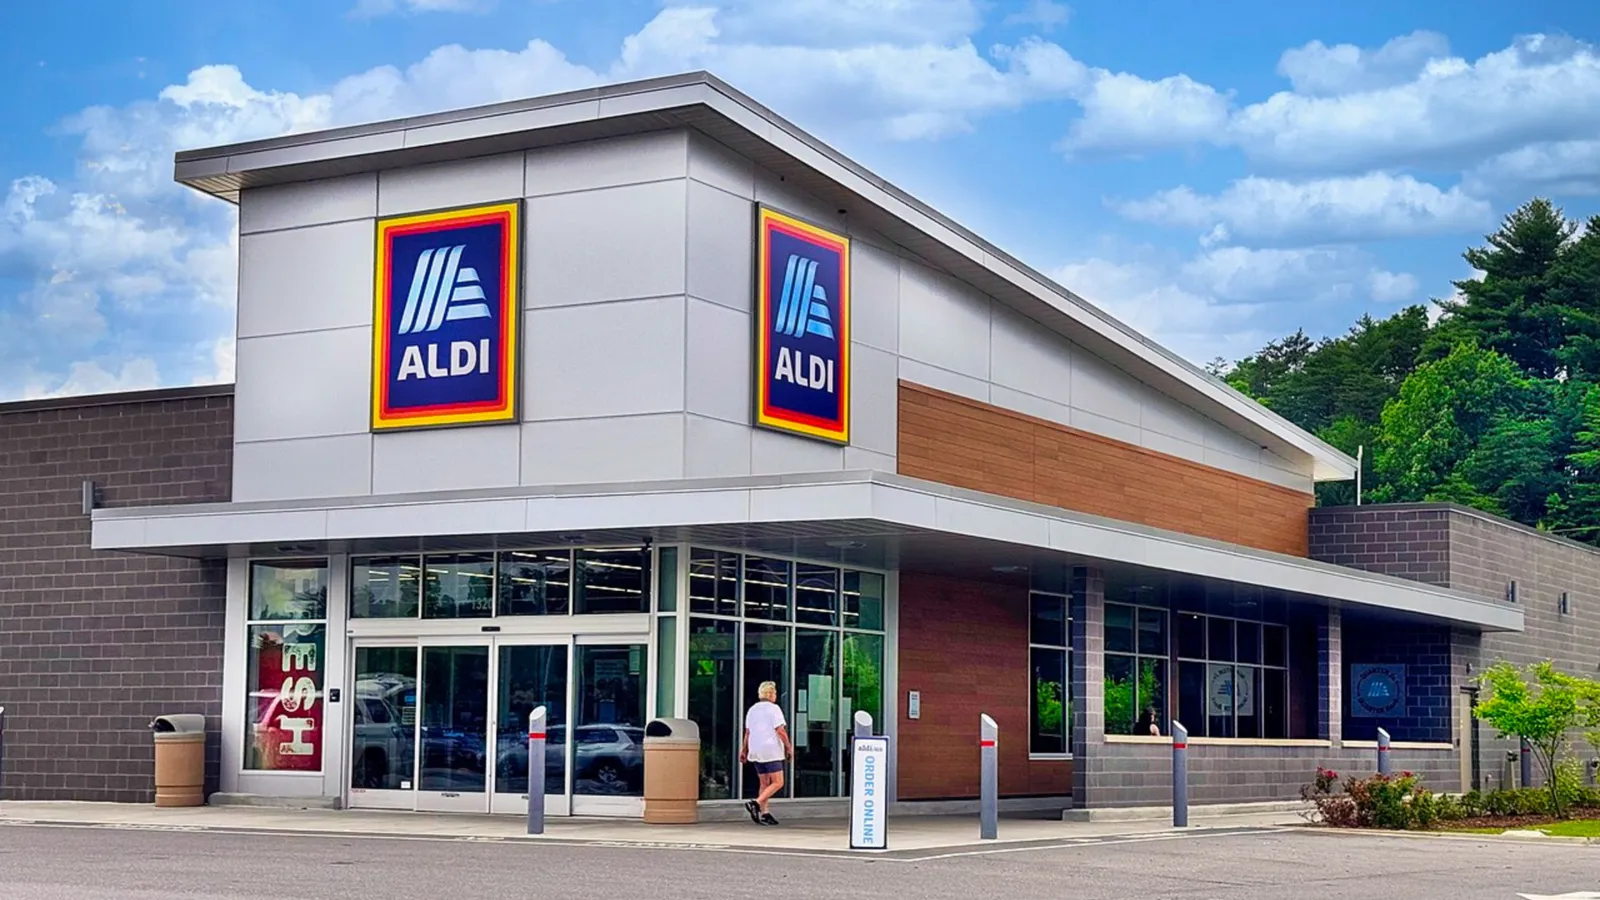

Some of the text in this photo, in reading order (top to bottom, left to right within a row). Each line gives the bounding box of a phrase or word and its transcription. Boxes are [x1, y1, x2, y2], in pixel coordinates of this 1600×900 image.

[397, 338, 490, 381] ALDI
[775, 346, 834, 393] ALDI
[276, 568, 318, 755] FRESH
[863, 755, 876, 844] ORDER ONLINE
